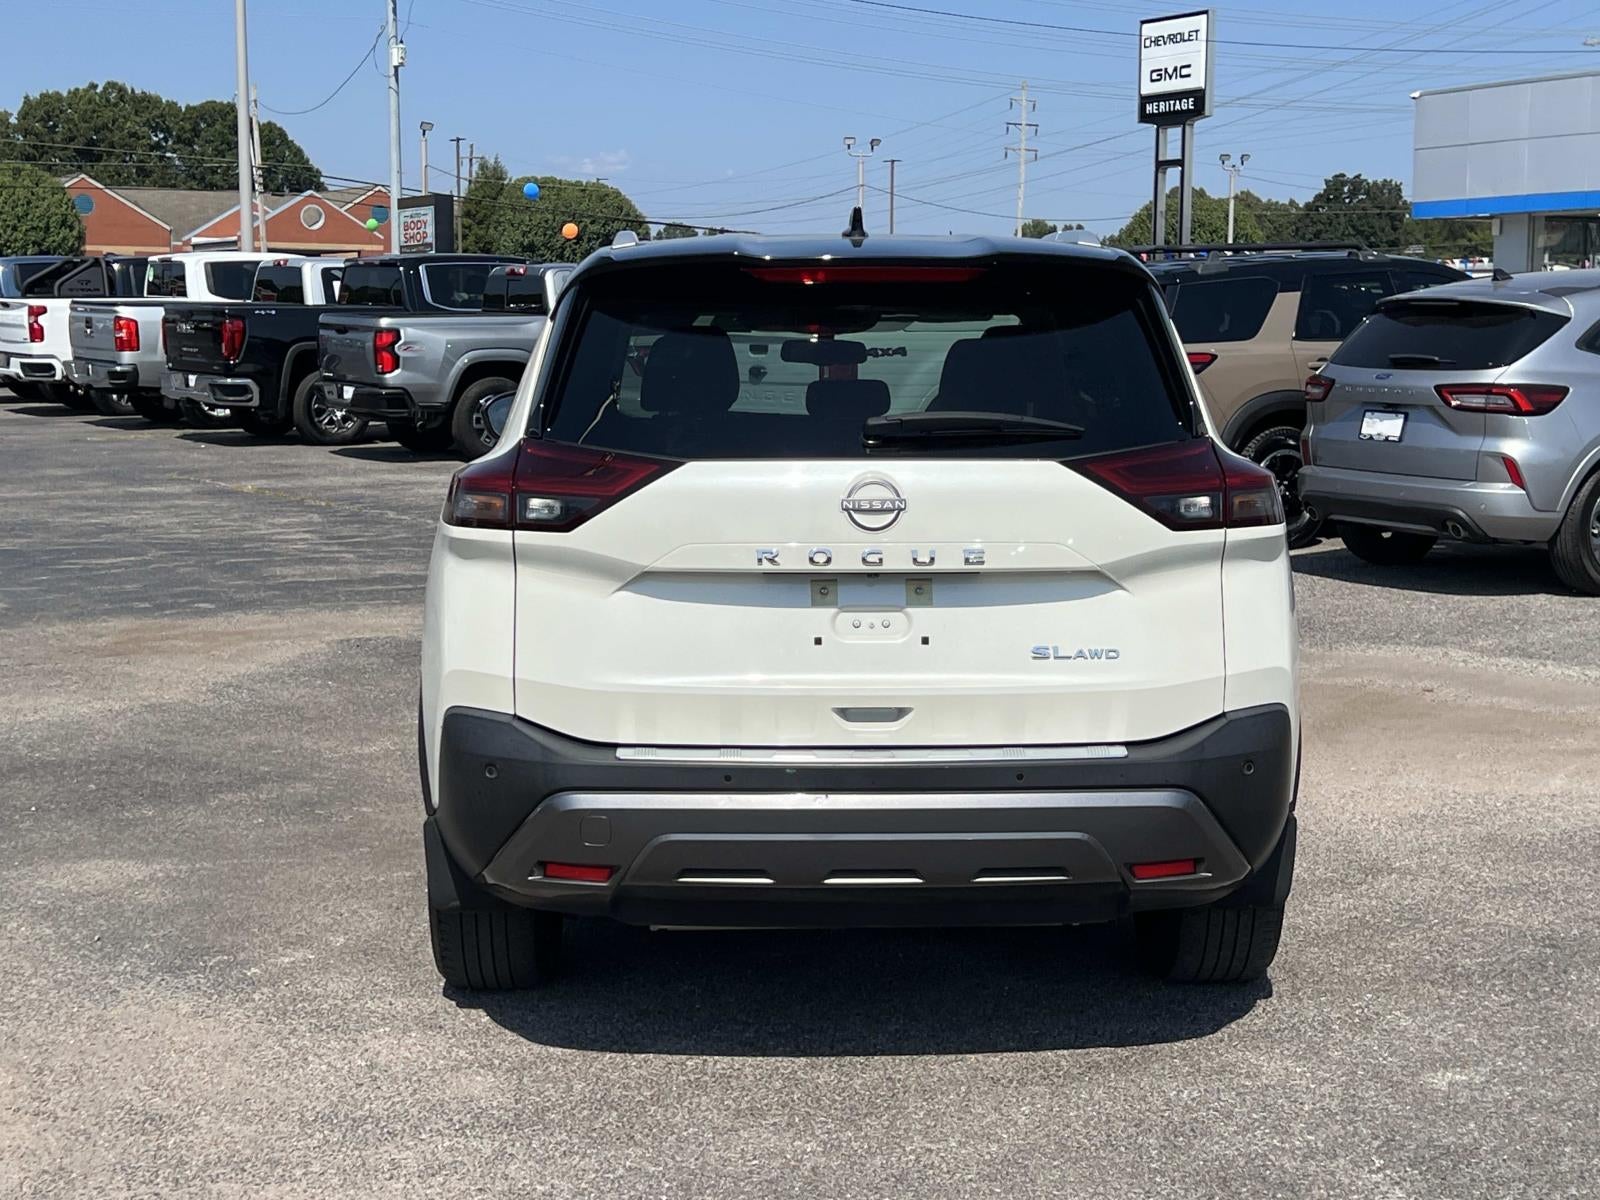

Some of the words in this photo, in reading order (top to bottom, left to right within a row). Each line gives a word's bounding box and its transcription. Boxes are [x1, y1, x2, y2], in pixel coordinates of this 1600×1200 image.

[1143, 29, 1200, 49] CHEVROLET
[1150, 63, 1192, 83] GMC
[1145, 97, 1195, 115] HERITAGE
[403, 219, 428, 232] BODY
[403, 230, 428, 244] SHOP
[842, 499, 905, 510] NISSAN
[755, 547, 986, 567] ROGUE
